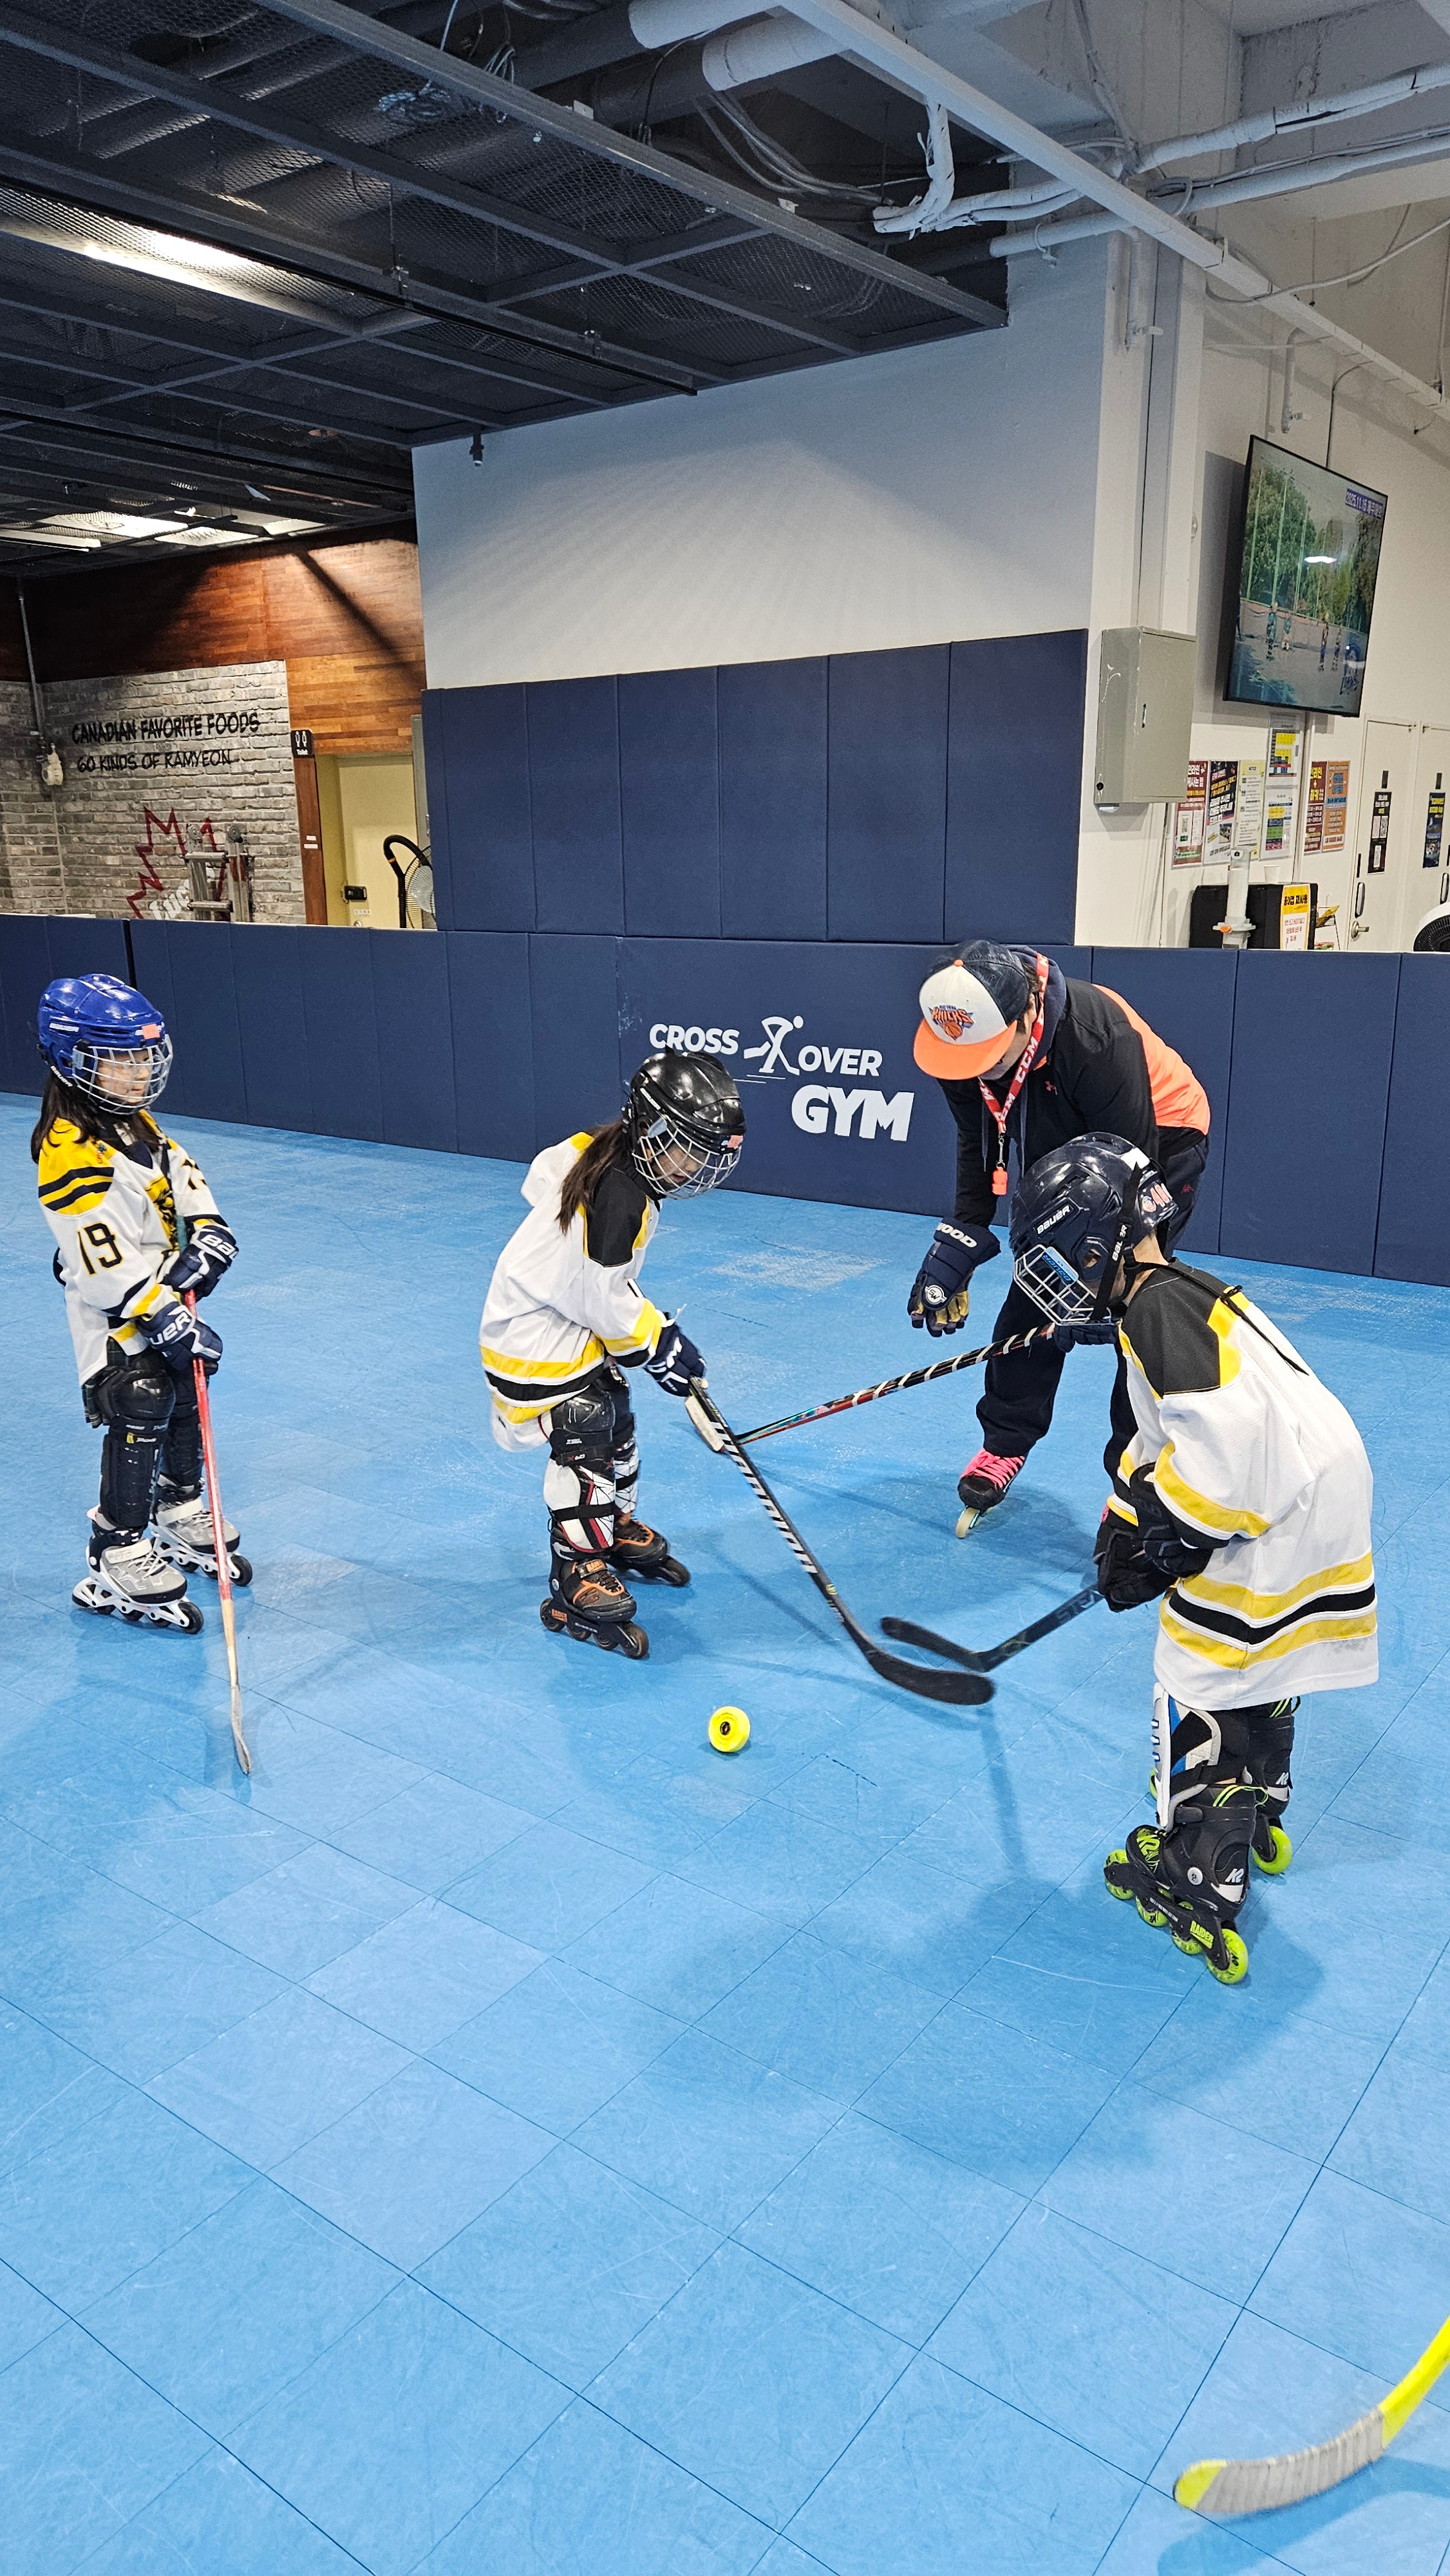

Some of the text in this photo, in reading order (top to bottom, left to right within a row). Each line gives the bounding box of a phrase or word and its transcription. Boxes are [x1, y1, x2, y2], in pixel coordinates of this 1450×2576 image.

[71, 712, 261, 744] CANADIAN FAVORITE FOODS
[77, 749, 232, 772] 60 KINDS OF RAMYEON
[1284, 895, 1294, 906] 종이컵
[649, 1023, 883, 1077] CROSS OVER
[1015, 1036, 1039, 1083] CCM
[791, 1084, 915, 1142] GYM
[1037, 1204, 1071, 1235] BAUER
[77, 1222, 122, 1274] 19
[1225, 1868, 1244, 1883] K2
[1190, 1920, 1214, 1943] RAIDER
